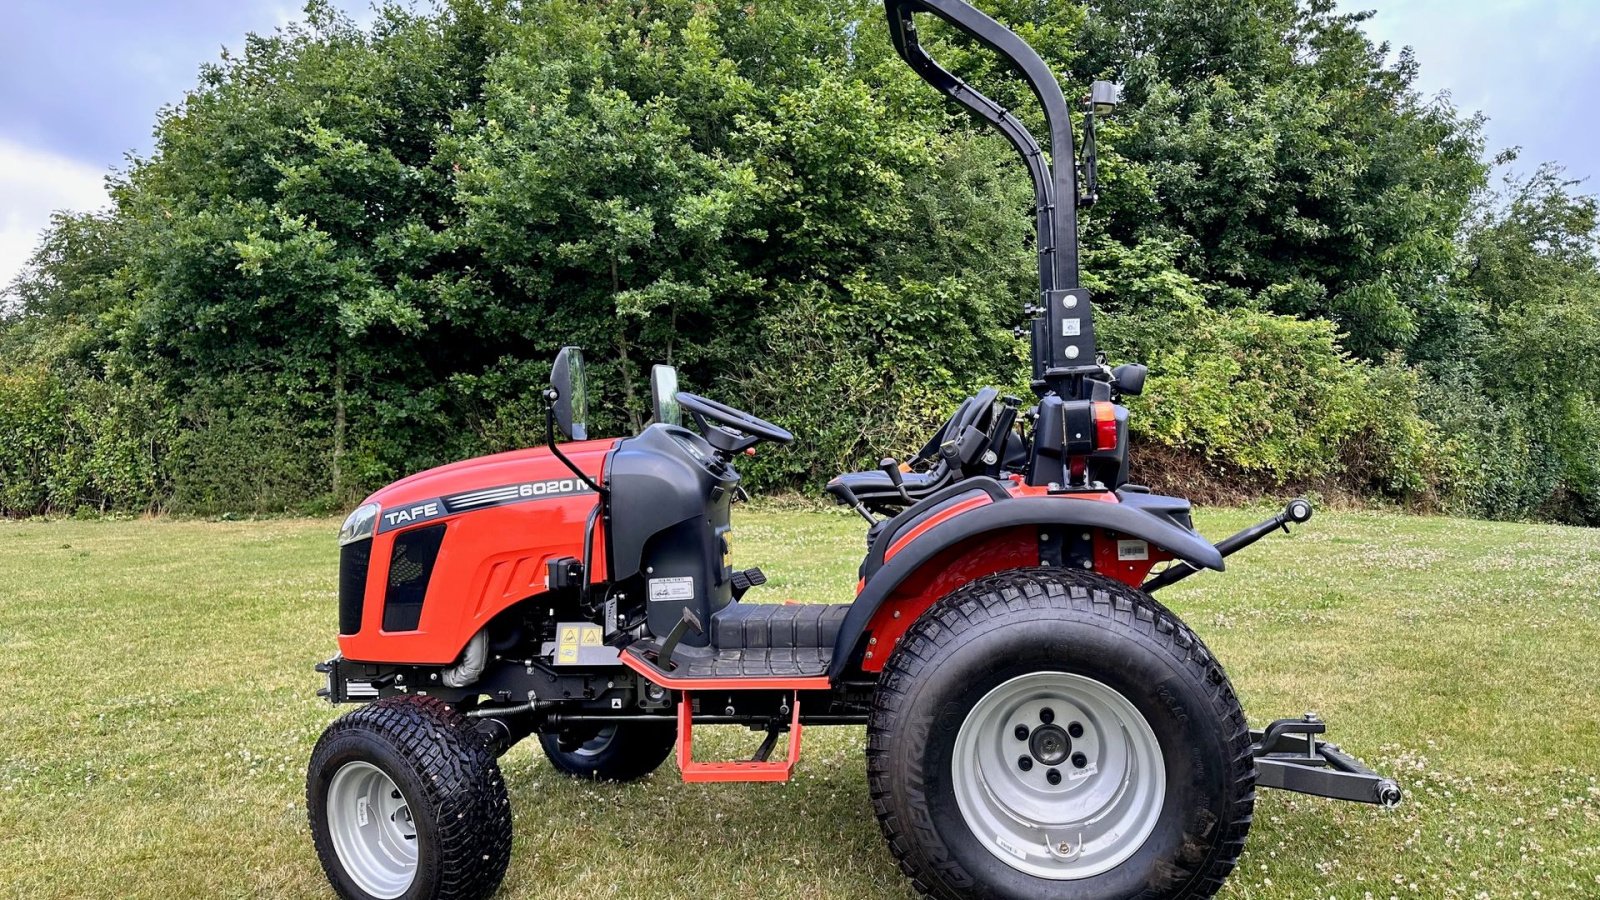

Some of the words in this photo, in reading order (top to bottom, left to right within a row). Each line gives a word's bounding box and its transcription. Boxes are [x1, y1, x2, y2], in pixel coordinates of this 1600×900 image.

[519, 480, 573, 497] 6020
[384, 503, 438, 526] TAFE
[904, 712, 976, 889] GREENTRAX
